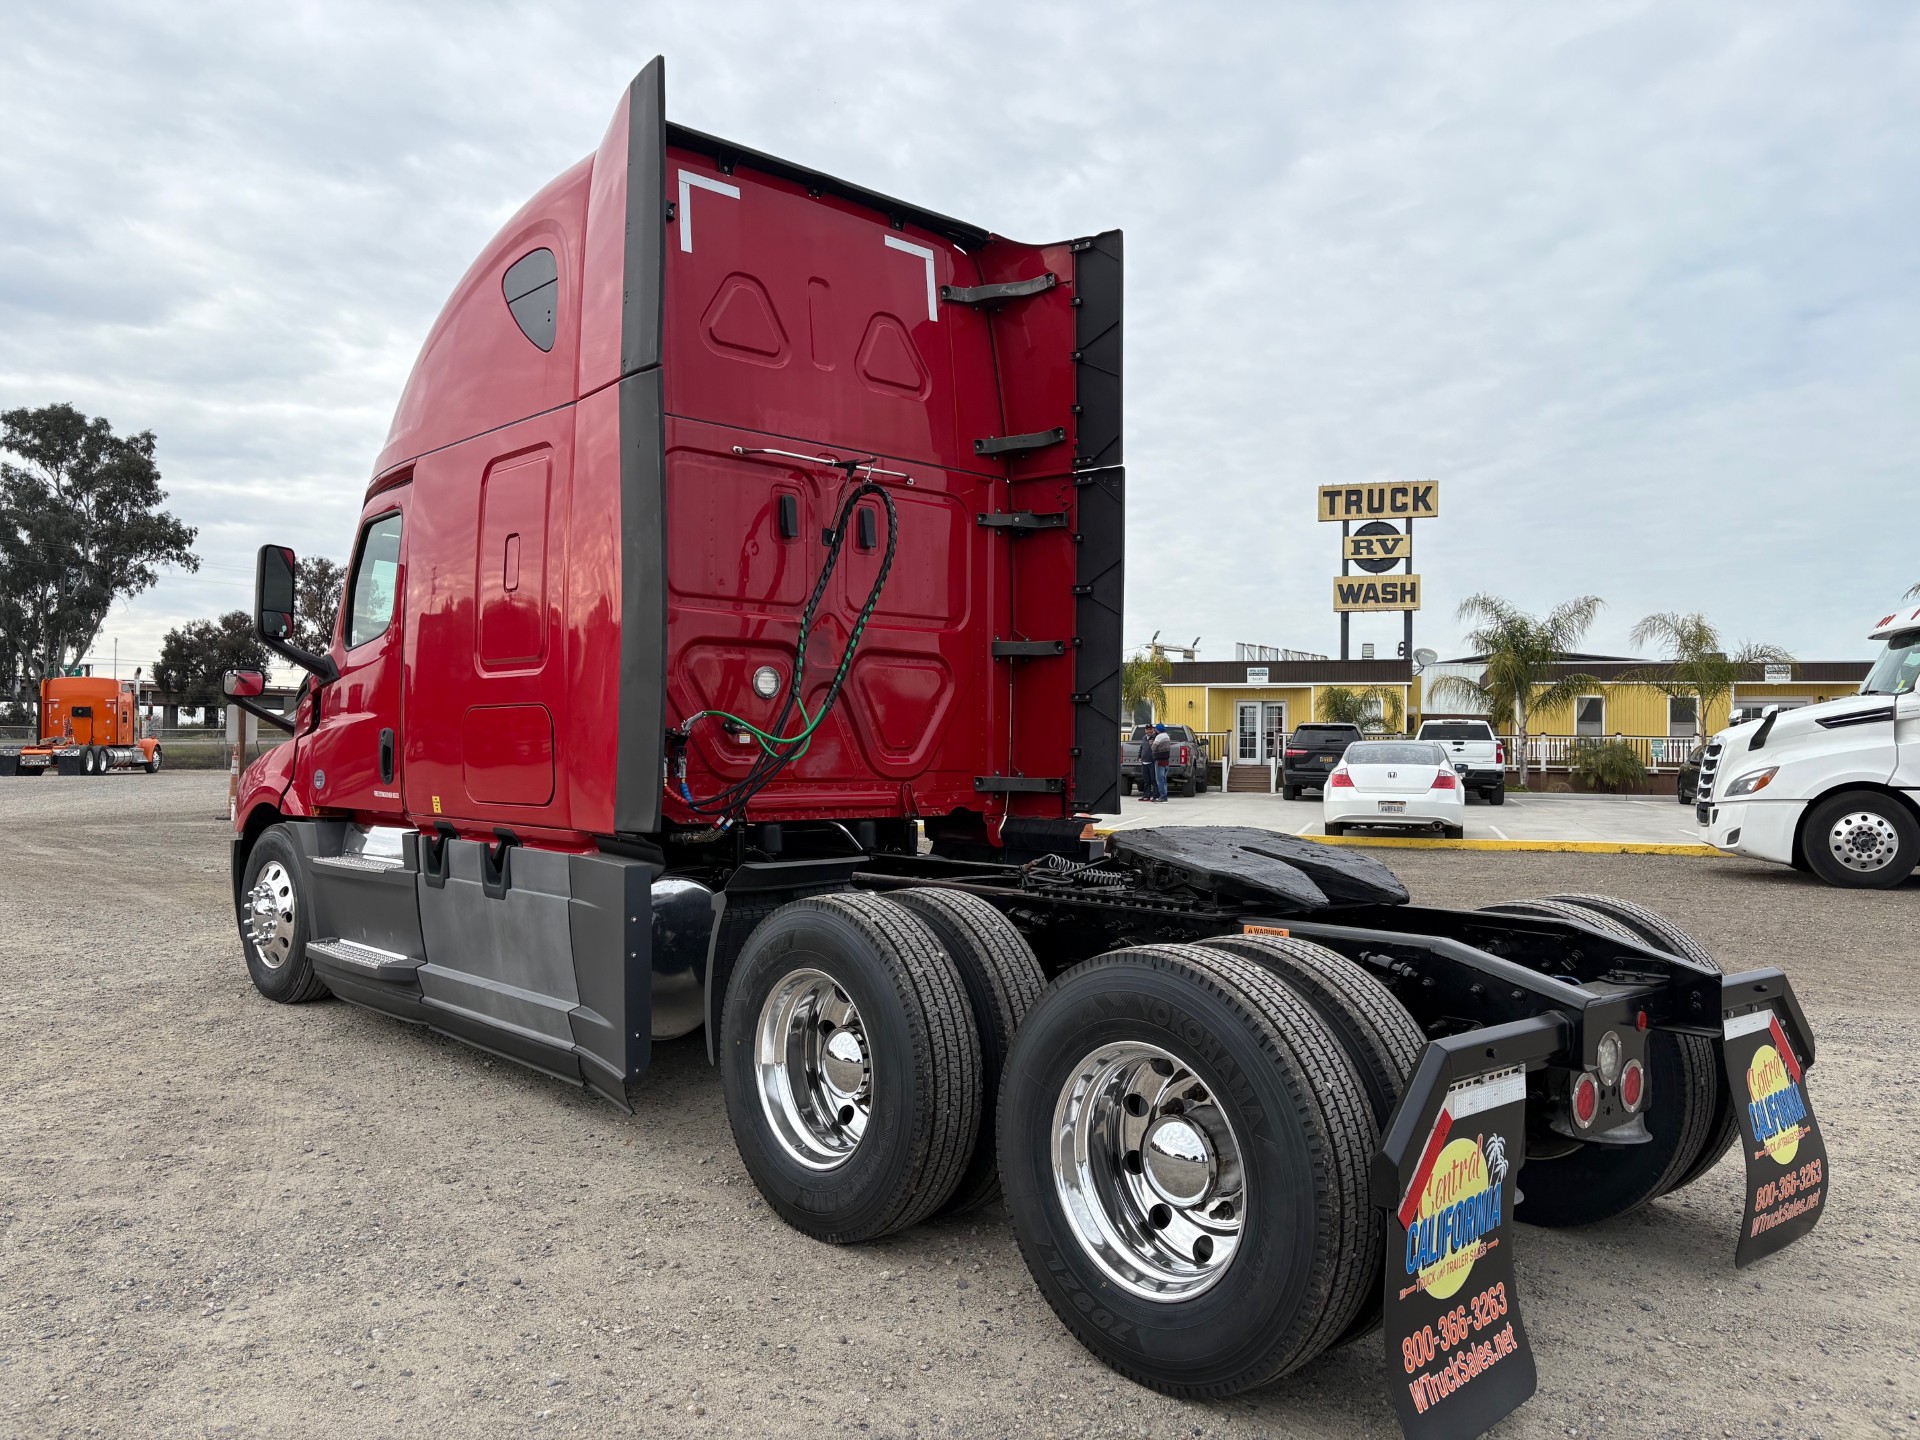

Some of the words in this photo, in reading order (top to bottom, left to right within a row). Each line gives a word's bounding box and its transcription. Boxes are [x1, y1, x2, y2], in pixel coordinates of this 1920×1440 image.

[1323, 486, 1433, 515] TRUCK
[1351, 538, 1403, 555] RV
[1337, 582, 1416, 604] WASH
[1253, 928, 1284, 937] WARNING
[1137, 996, 1264, 1132] YOKOHAMA
[1747, 1045, 1782, 1102] Central
[1749, 1083, 1807, 1142] CALIFORNIA
[1418, 1133, 1483, 1220] Central
[1754, 1158, 1822, 1212] 800-366-3263
[1406, 1183, 1502, 1274] CALIFORNIA
[1046, 1250, 1132, 1342] 709ZL
[1416, 1269, 1436, 1293] TRUCK
[1446, 1252, 1469, 1275] TRAILER
[1469, 1241, 1487, 1263] SALES
[1402, 1281, 1508, 1374] 800-366-3263
[1409, 1321, 1518, 1414] WTruckSales.net
